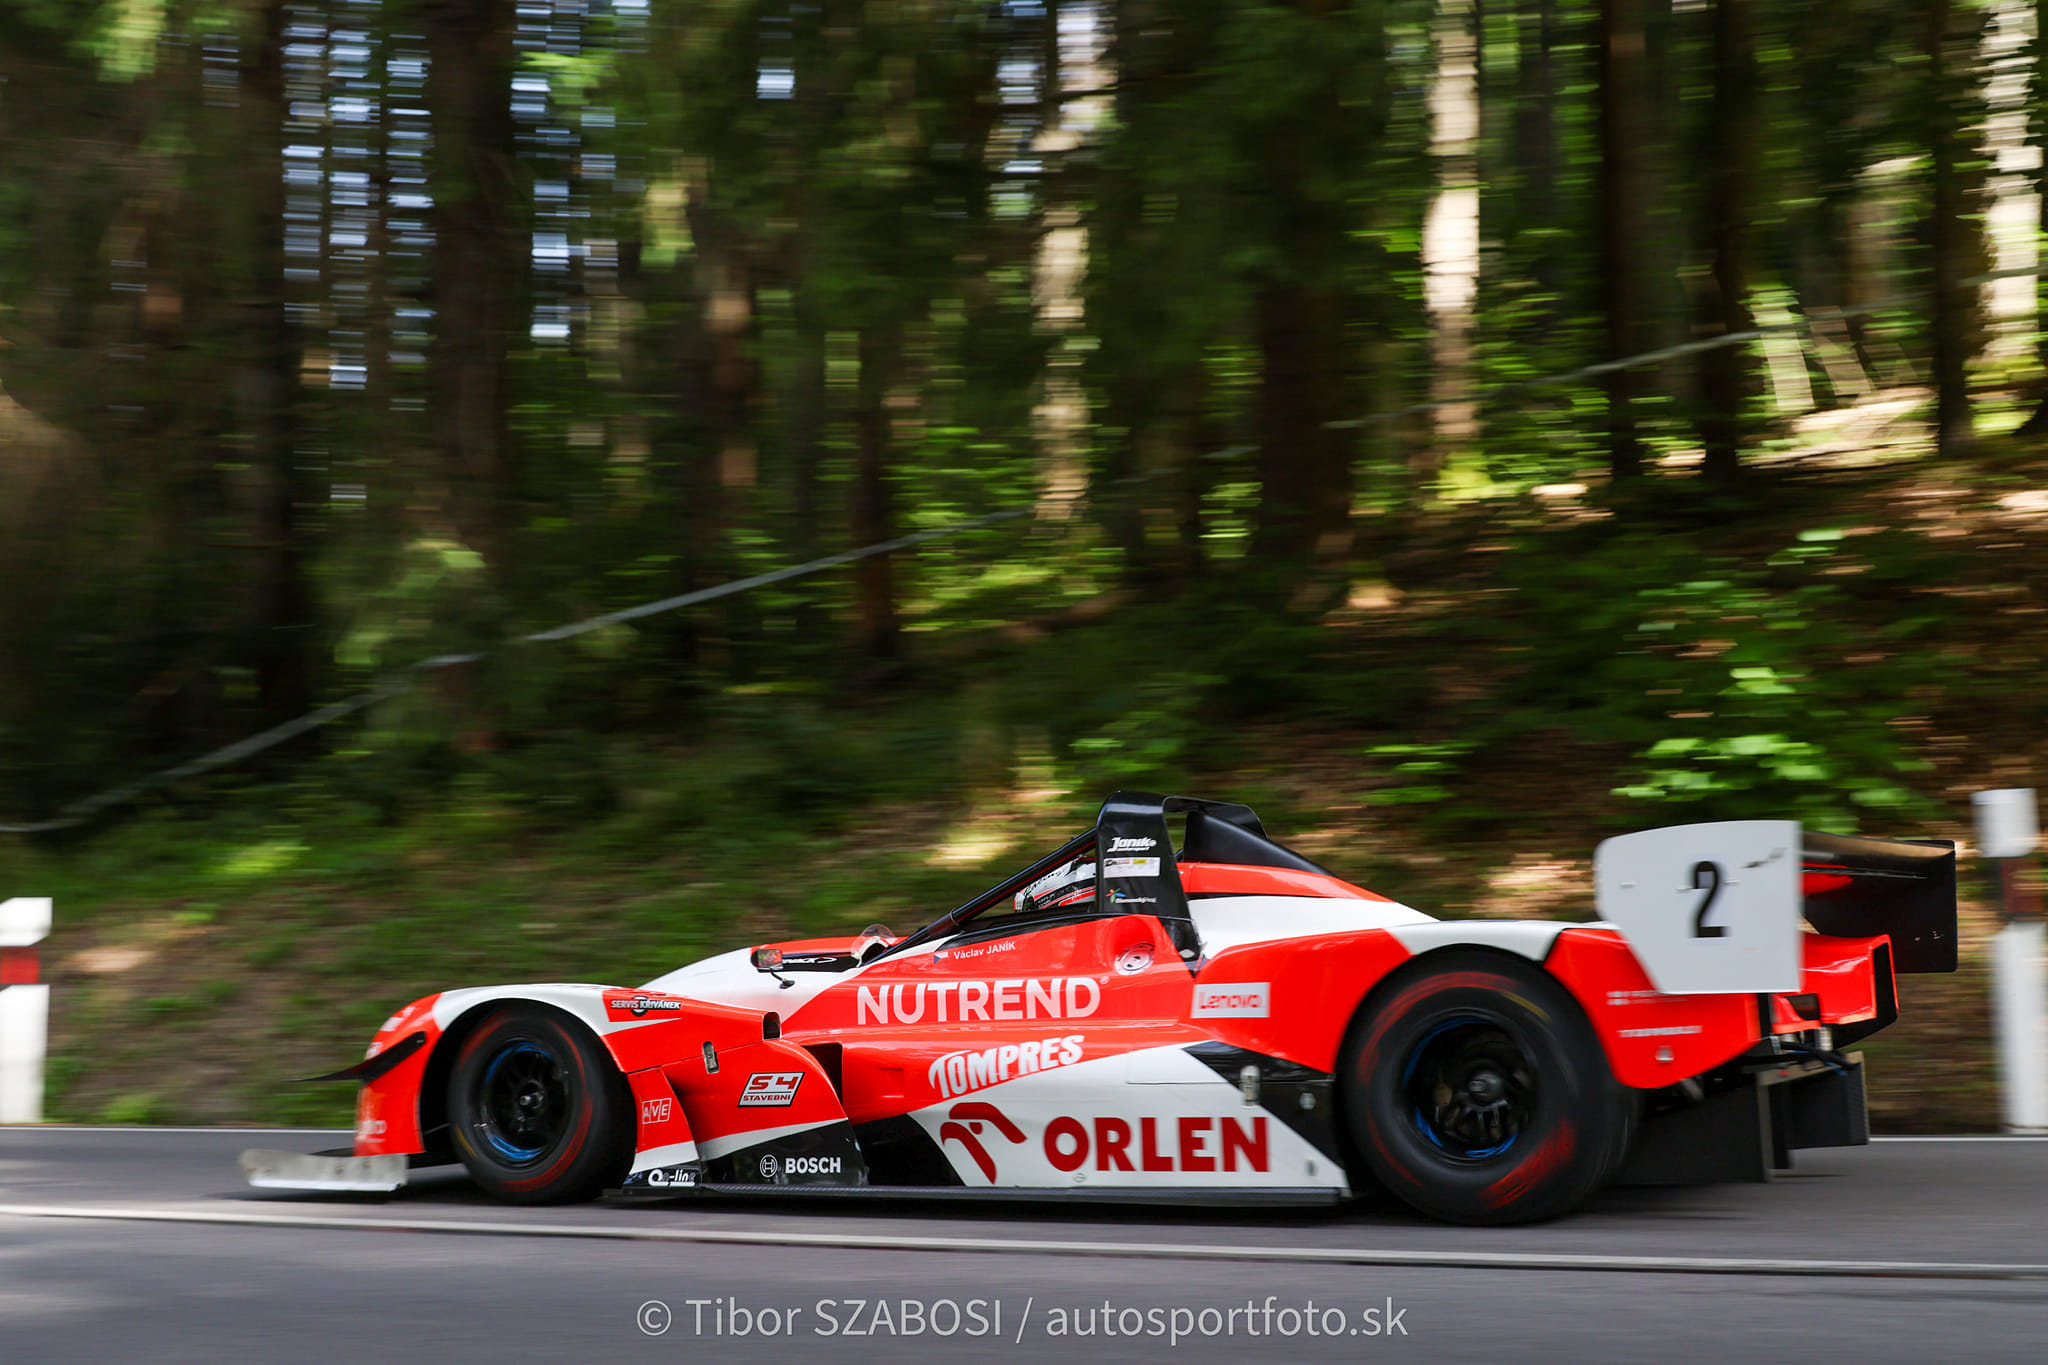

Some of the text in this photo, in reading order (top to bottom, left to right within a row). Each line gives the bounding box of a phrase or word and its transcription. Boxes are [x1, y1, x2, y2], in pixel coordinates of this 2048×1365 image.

[1690, 860, 1730, 938] 2
[954, 940, 1016, 960] Václav JANÍK
[611, 1000, 639, 1009] SERVIS
[1199, 991, 1264, 1009] Lenovo
[928, 1035, 1085, 1098] TOMPRES
[642, 1103, 669, 1119] AVE
[1043, 1116, 1271, 1172] ORLEN
[785, 1157, 841, 1174] BOSCH
